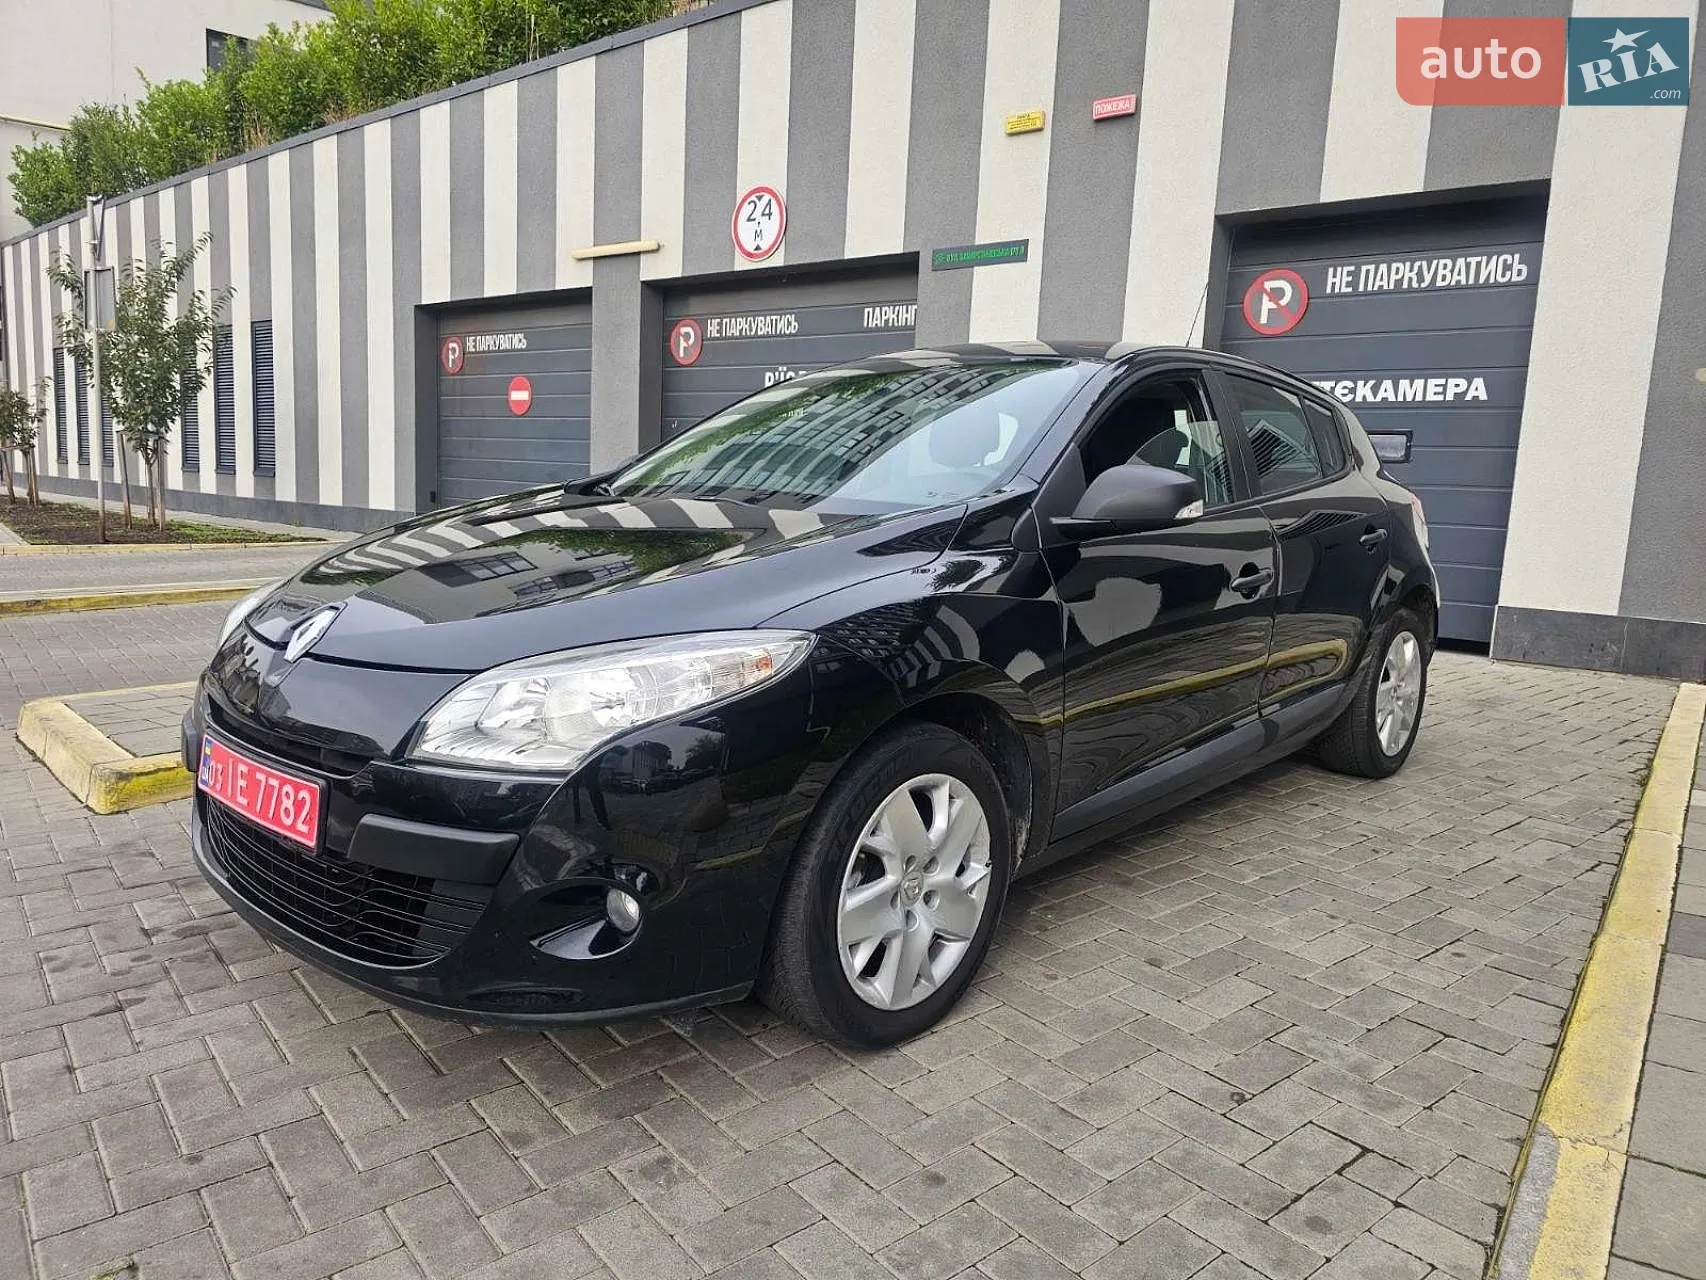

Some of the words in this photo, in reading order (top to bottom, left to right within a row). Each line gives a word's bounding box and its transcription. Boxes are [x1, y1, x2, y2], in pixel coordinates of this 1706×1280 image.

[1326, 266, 1355, 294] НЕ
[1358, 253, 1528, 292] ПАРКУВАТИСЬ
[707, 318, 721, 338] НЕ
[723, 314, 799, 337] ПАРКУВАТИСЬ
[466, 336, 476, 352] НЕ
[477, 333, 527, 351] ПАРКУВАТИСЬ
[1309, 377, 1488, 402] ТЄКАМЕРА
[255, 771, 312, 834] 7782
